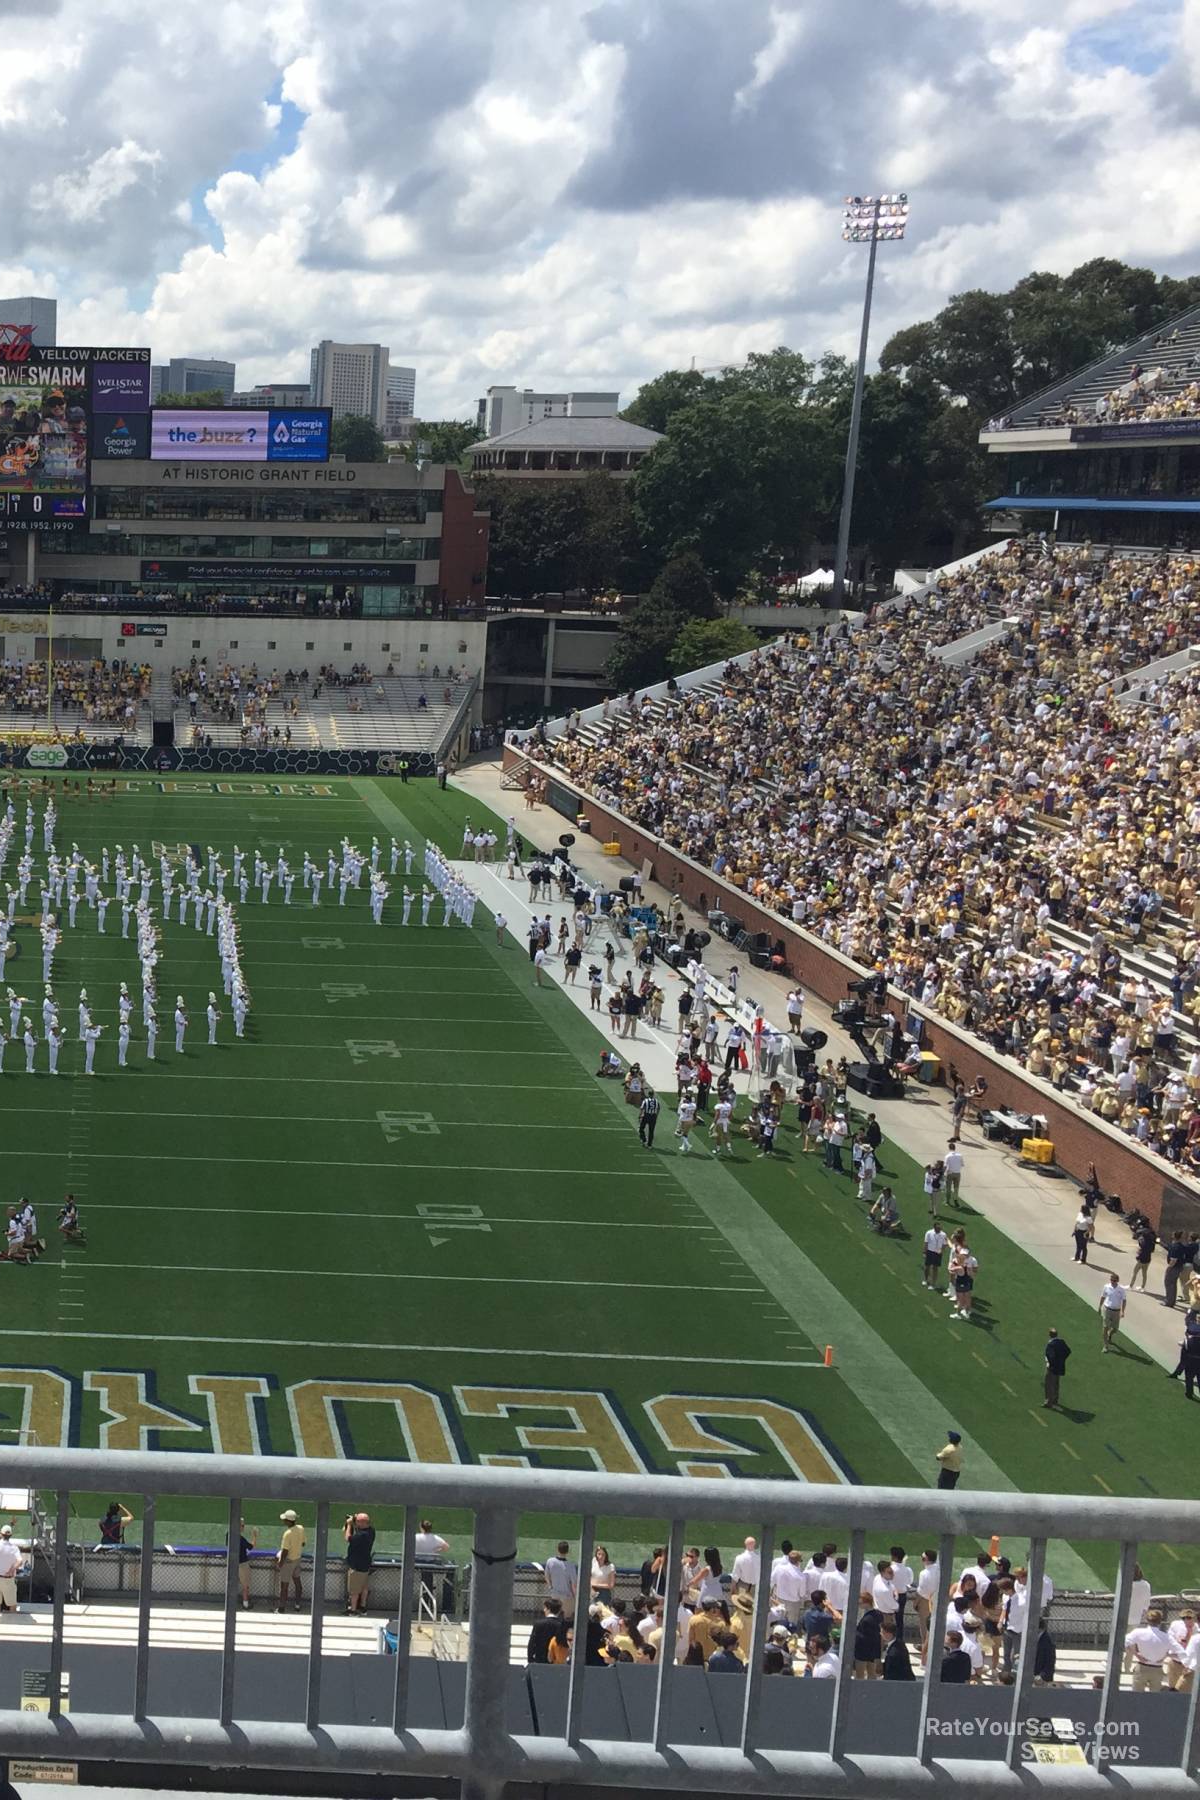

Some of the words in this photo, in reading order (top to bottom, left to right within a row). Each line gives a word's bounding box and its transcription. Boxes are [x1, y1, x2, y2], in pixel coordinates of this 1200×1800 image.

[40, 350, 90, 360] YELLOW
[93, 350, 149, 361] JACKETS
[291, 420, 323, 428] Georgia
[168, 426, 197, 442] the
[292, 428, 322, 436] Natural
[104, 436, 136, 447] Georgia
[108, 446, 133, 455] Power
[162, 468, 181, 480] AT
[186, 468, 254, 481] HISTORIC
[260, 469, 310, 481] GRANT
[314, 470, 356, 482] FIELD
[53, 522, 74, 530] 1990
[30, 750, 65, 764] sage
[14, 1764, 54, 1772] Production
